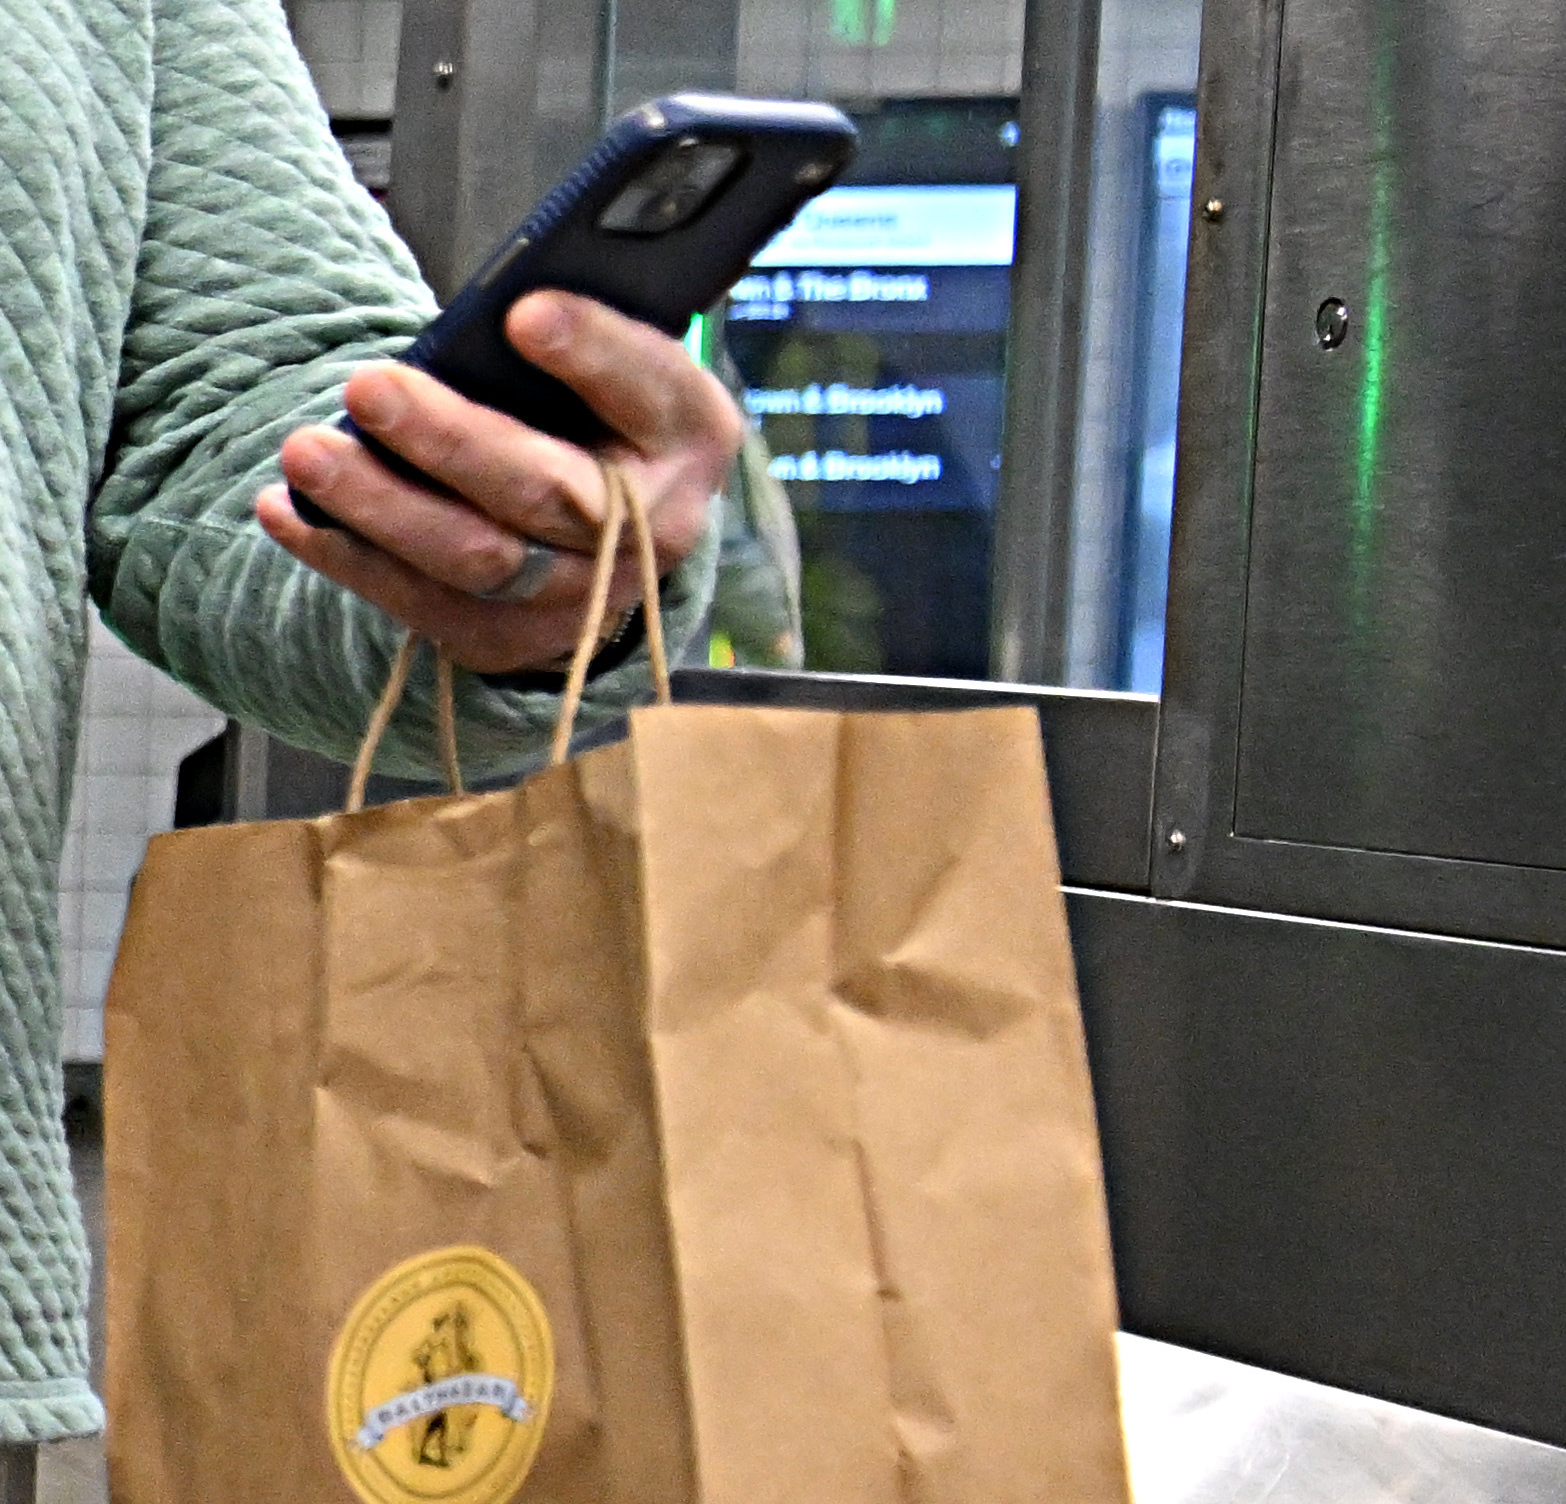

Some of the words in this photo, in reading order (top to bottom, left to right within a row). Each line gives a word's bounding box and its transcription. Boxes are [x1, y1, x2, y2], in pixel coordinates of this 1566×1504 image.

[849, 268, 929, 302] Bronx
[824, 382, 946, 419] Brooklyn
[820, 449, 942, 484] Brooklyn
